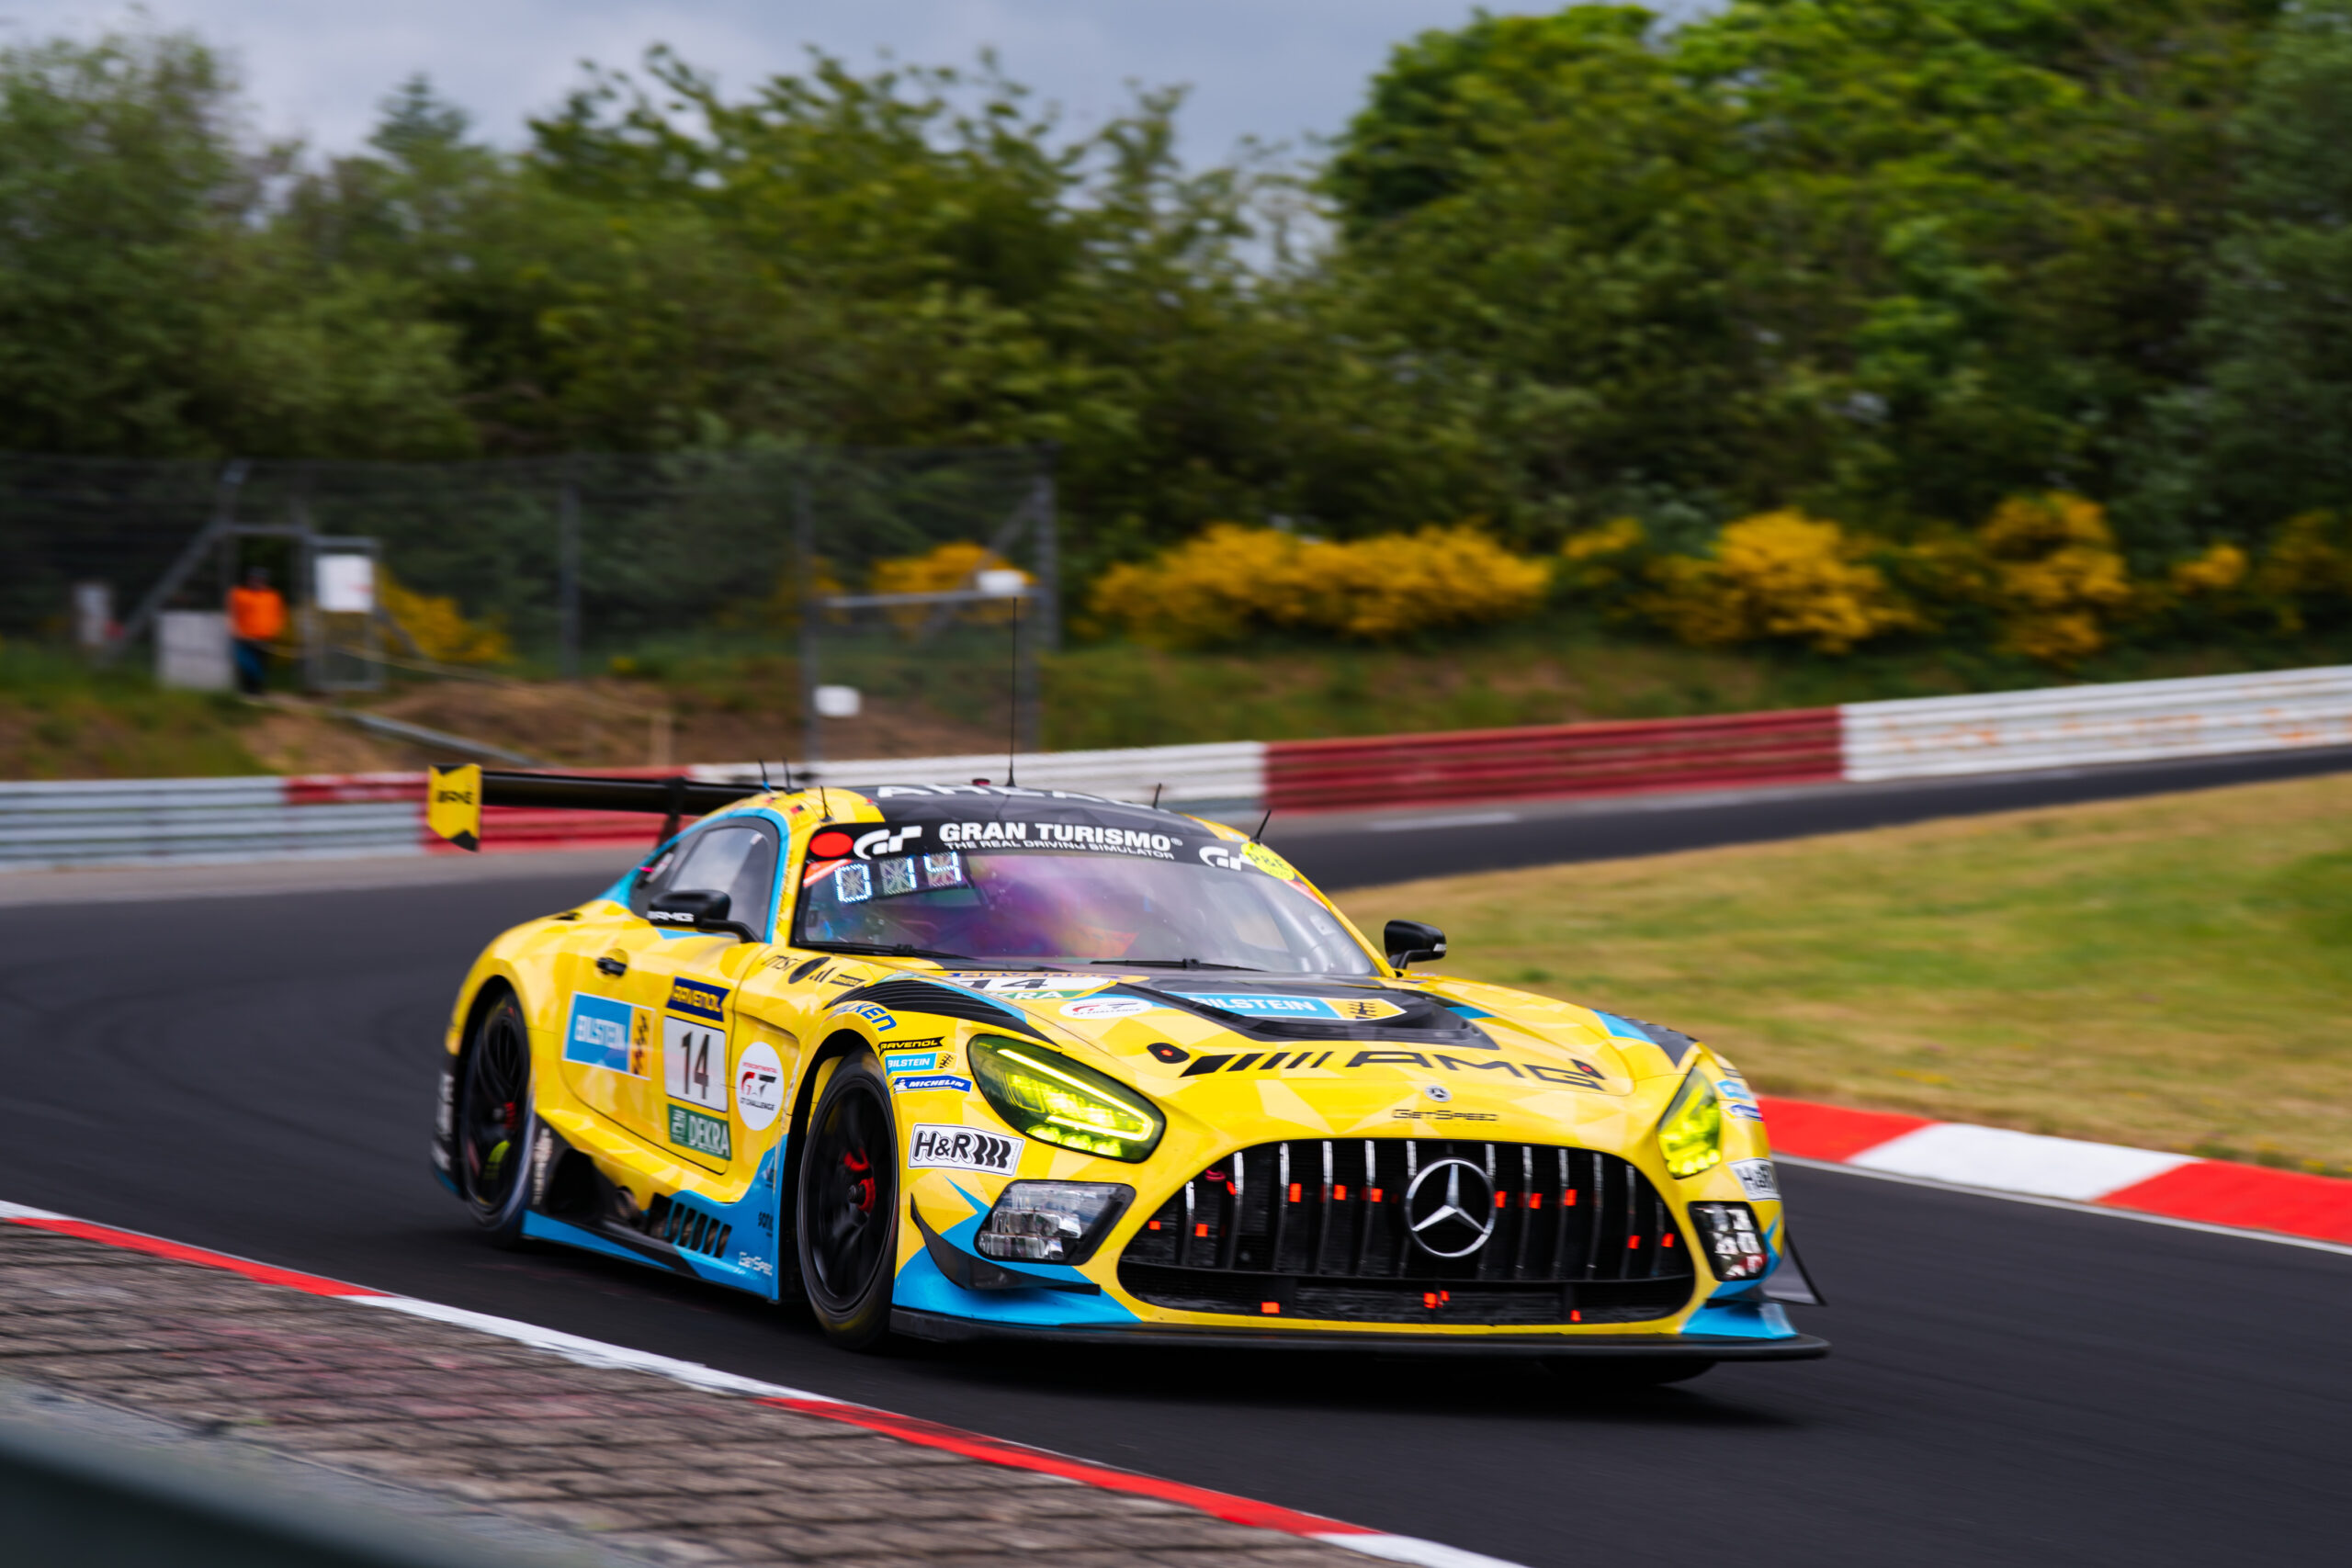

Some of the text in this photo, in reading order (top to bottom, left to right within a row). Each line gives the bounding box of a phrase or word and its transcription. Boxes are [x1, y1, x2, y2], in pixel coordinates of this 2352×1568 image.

[939, 822, 1026, 842] GRAN
[944, 840, 1175, 860] THE REAL DRIVING SIMULATOR
[834, 851, 962, 904] 014
[960, 978, 1047, 989] 14
[1189, 998, 1317, 1011] BILSTEIN
[573, 1014, 627, 1052] BILSTEIN
[879, 1039, 939, 1051] RAVENOL
[681, 1030, 710, 1100] 14
[888, 1057, 931, 1068] BILSTEIN
[1345, 1051, 1605, 1092] AMG
[909, 1079, 966, 1089] MICHELIN
[688, 1114, 731, 1157] DEKRA
[913, 1131, 971, 1162] H&R
